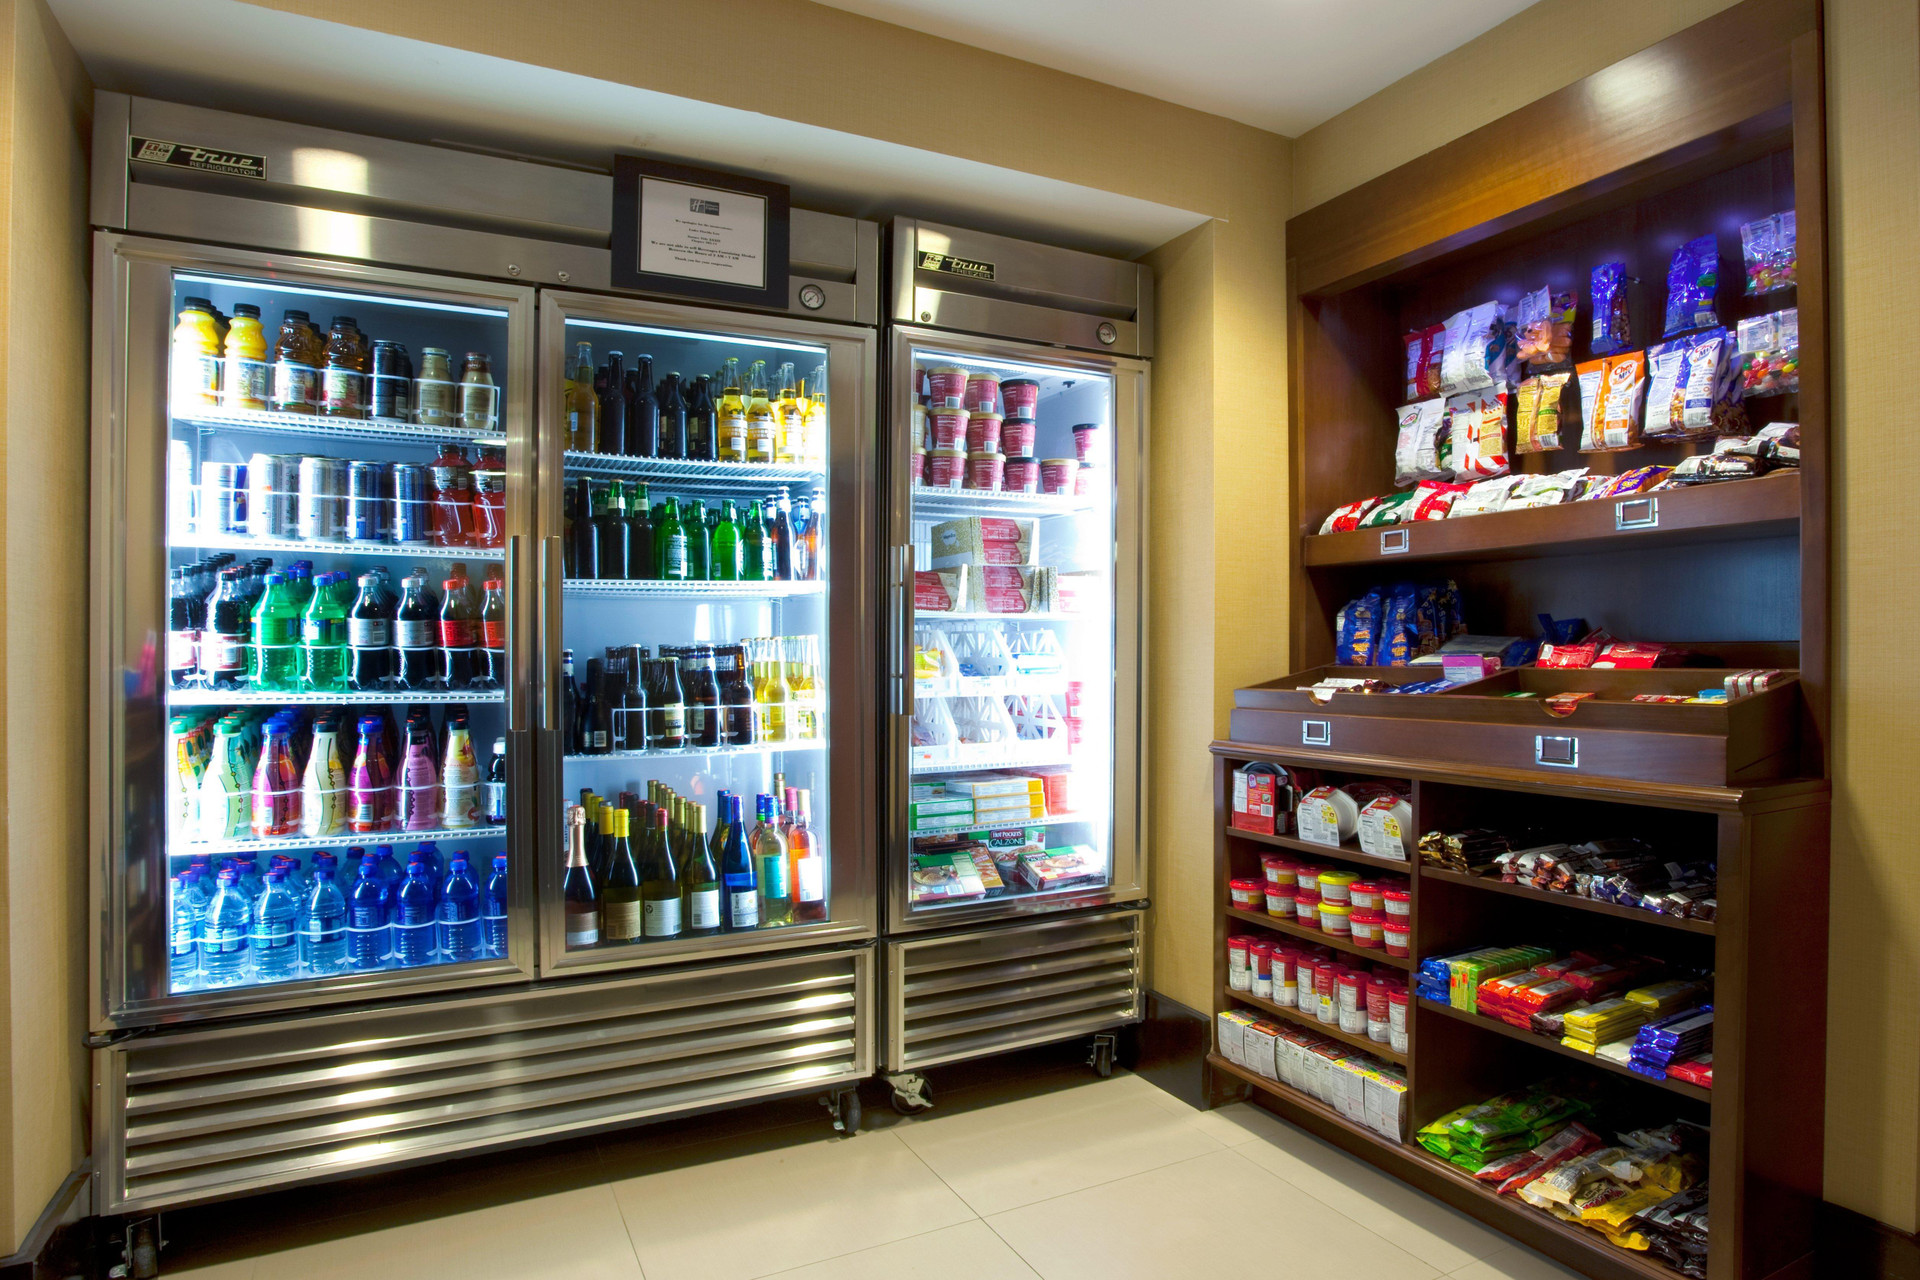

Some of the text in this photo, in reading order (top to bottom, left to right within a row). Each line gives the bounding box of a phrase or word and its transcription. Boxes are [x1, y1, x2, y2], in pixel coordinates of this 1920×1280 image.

[189, 161, 256, 176] REFRIGERATOR
[1614, 364, 1632, 375] Chex
[990, 838, 1024, 848] CALZONE
